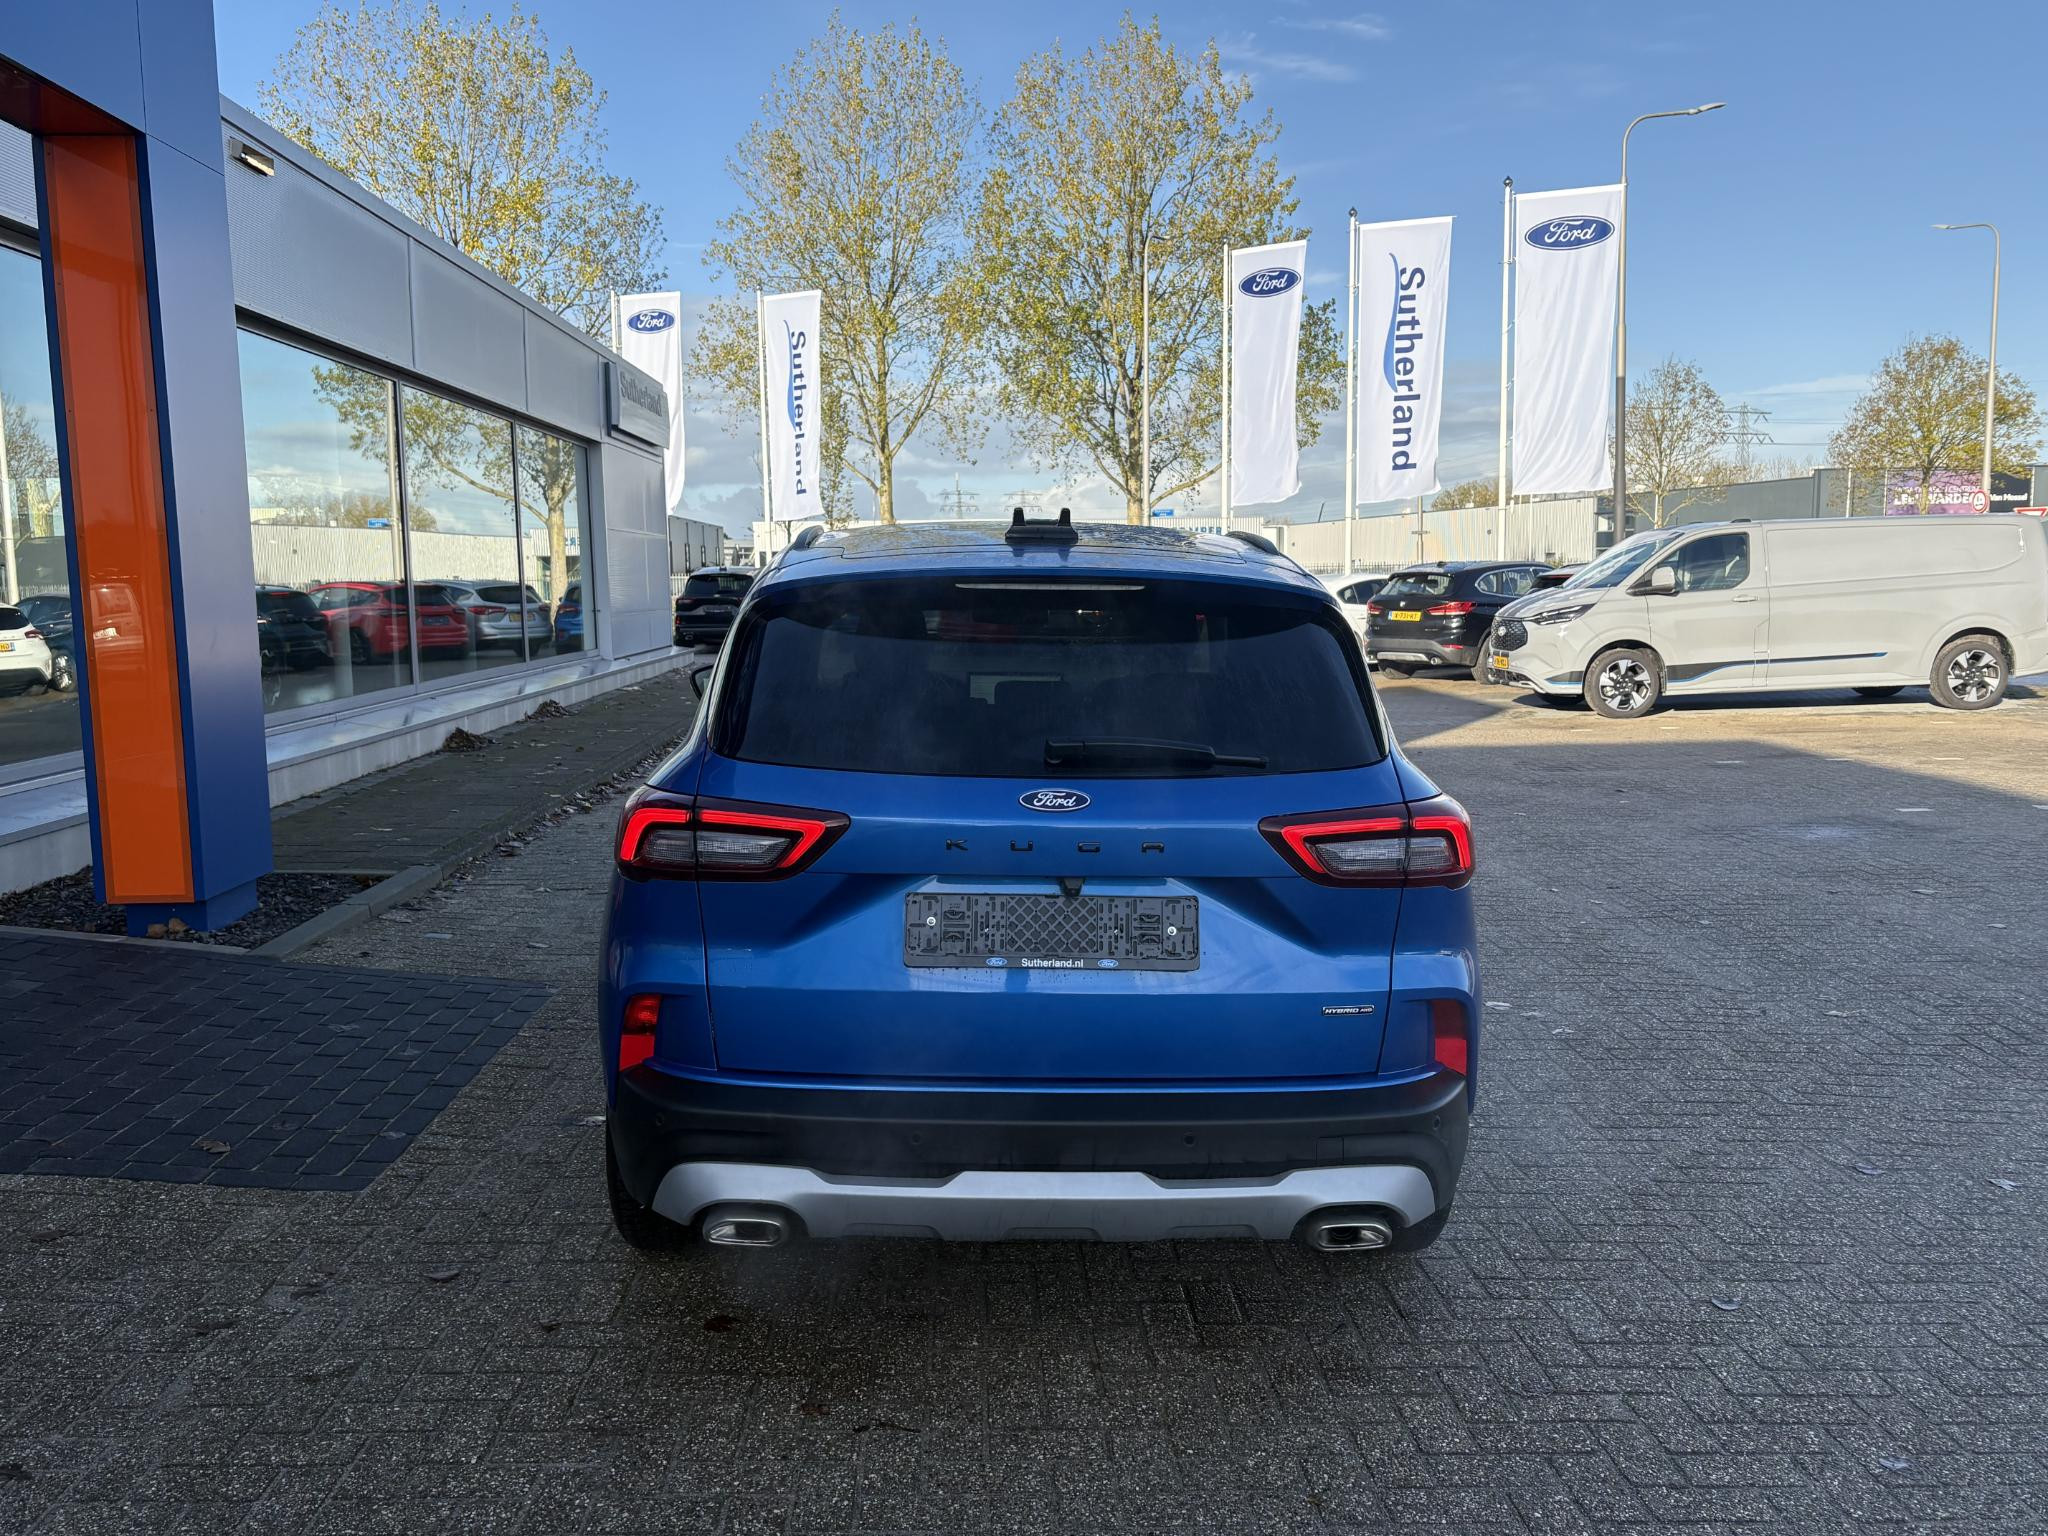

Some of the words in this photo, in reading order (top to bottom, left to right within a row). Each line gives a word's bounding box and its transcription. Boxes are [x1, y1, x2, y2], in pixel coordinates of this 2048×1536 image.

[1544, 219, 1597, 243] Ford
[1252, 271, 1288, 292] Ford
[637, 312, 666, 329] Ford
[1392, 267, 1426, 471] Sutherland
[620, 371, 662, 417] Sutherland
[791, 331, 807, 495] Sutherland
[1033, 791, 1077, 807] Ford
[945, 838, 1165, 853] KUGA
[1021, 957, 1084, 968] Sutherland.nl
